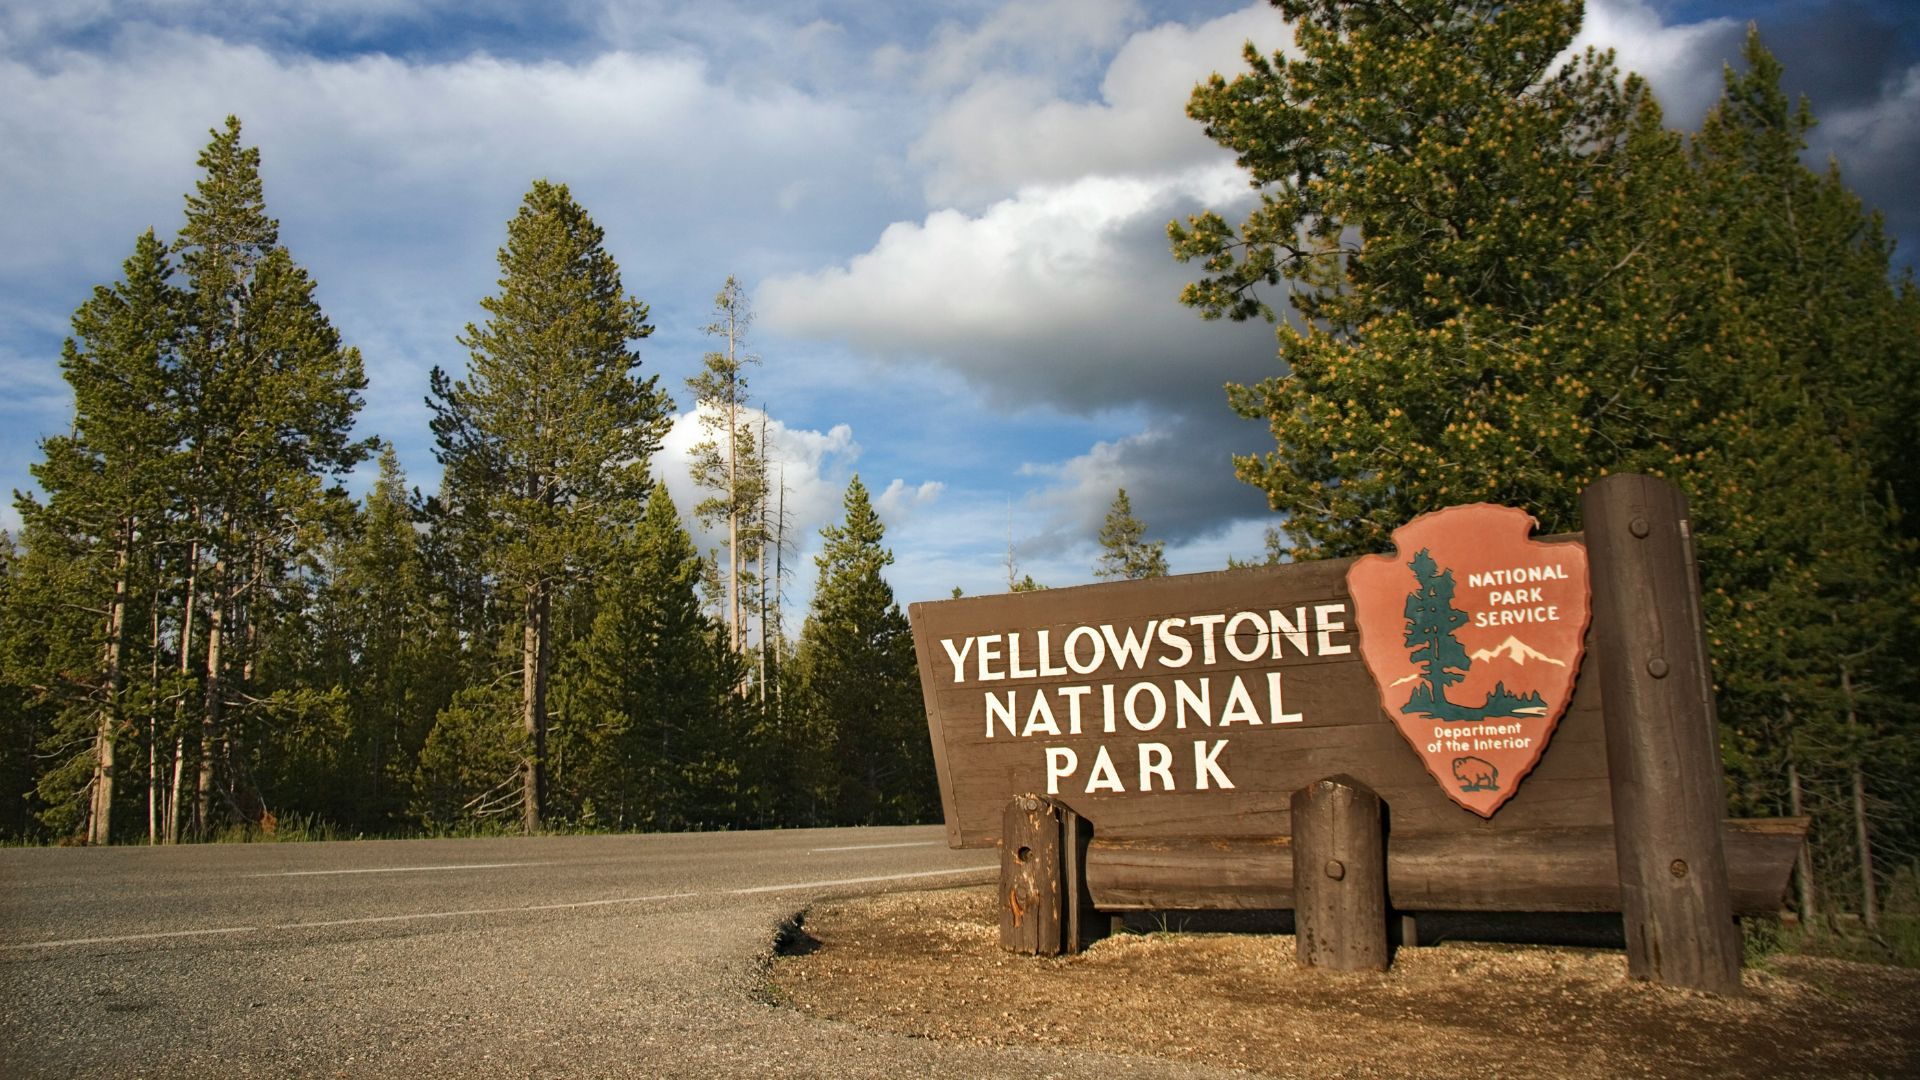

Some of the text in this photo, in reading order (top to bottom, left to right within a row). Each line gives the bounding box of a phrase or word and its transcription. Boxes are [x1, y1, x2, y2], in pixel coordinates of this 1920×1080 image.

[1468, 564, 1568, 588] NATIONAL
[1489, 587, 1543, 606] PARK
[1474, 606, 1560, 628] SERVICE
[940, 603, 1352, 684] YELLOWSTONE
[984, 672, 1303, 738] NATIONAL
[1434, 722, 1522, 741] Department
[1427, 737, 1532, 753] of the Interior
[1045, 739, 1236, 795] PARK
